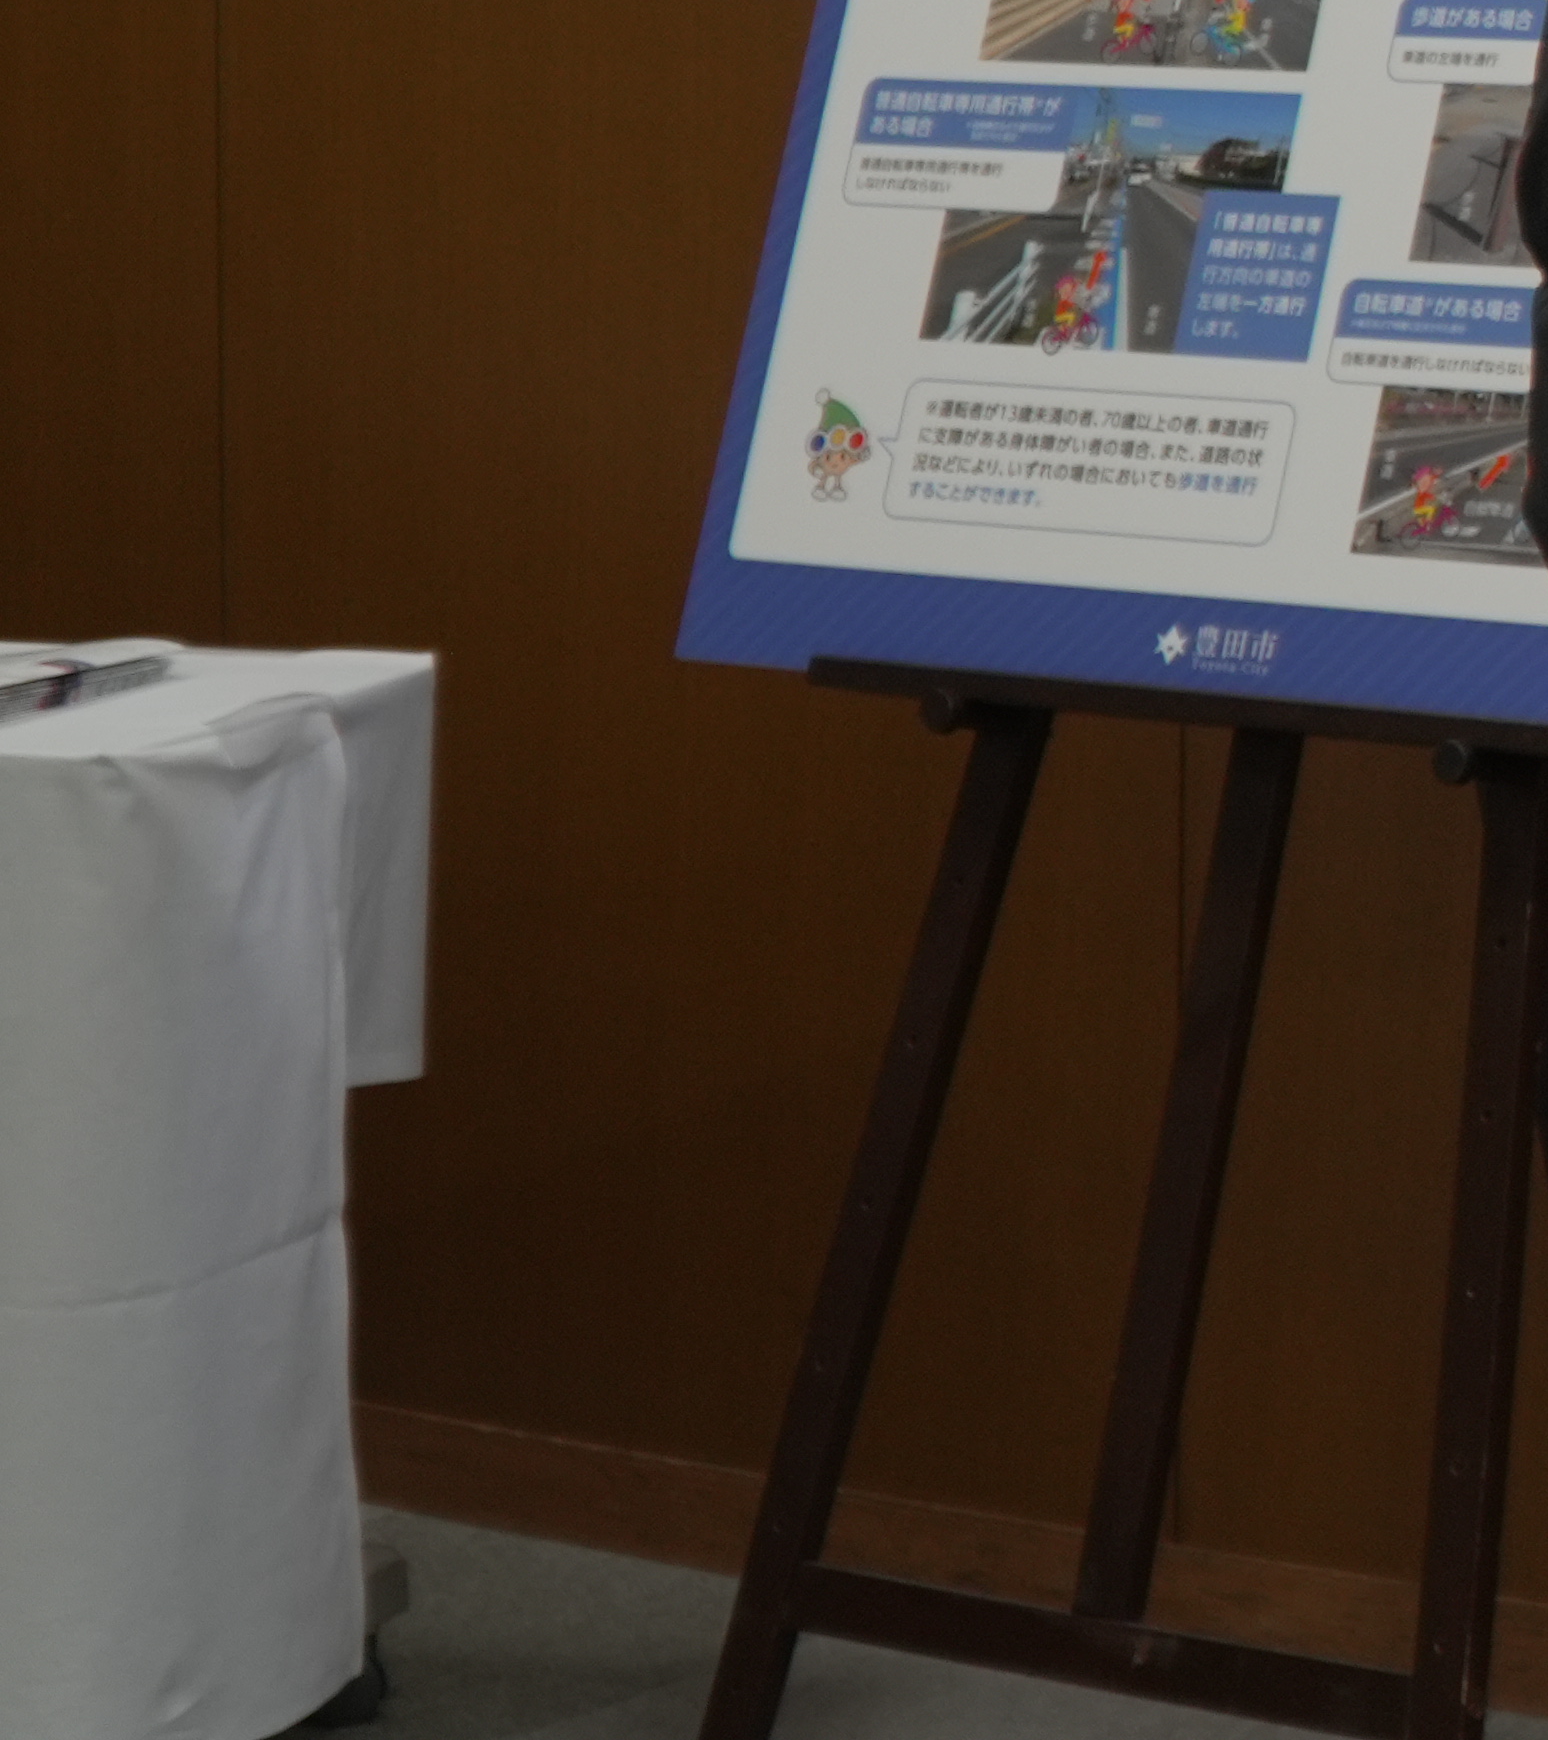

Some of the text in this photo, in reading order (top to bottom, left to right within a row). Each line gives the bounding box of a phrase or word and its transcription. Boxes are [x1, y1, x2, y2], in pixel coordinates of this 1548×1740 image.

[1411, 6, 1534, 32] 歩道がある場合
